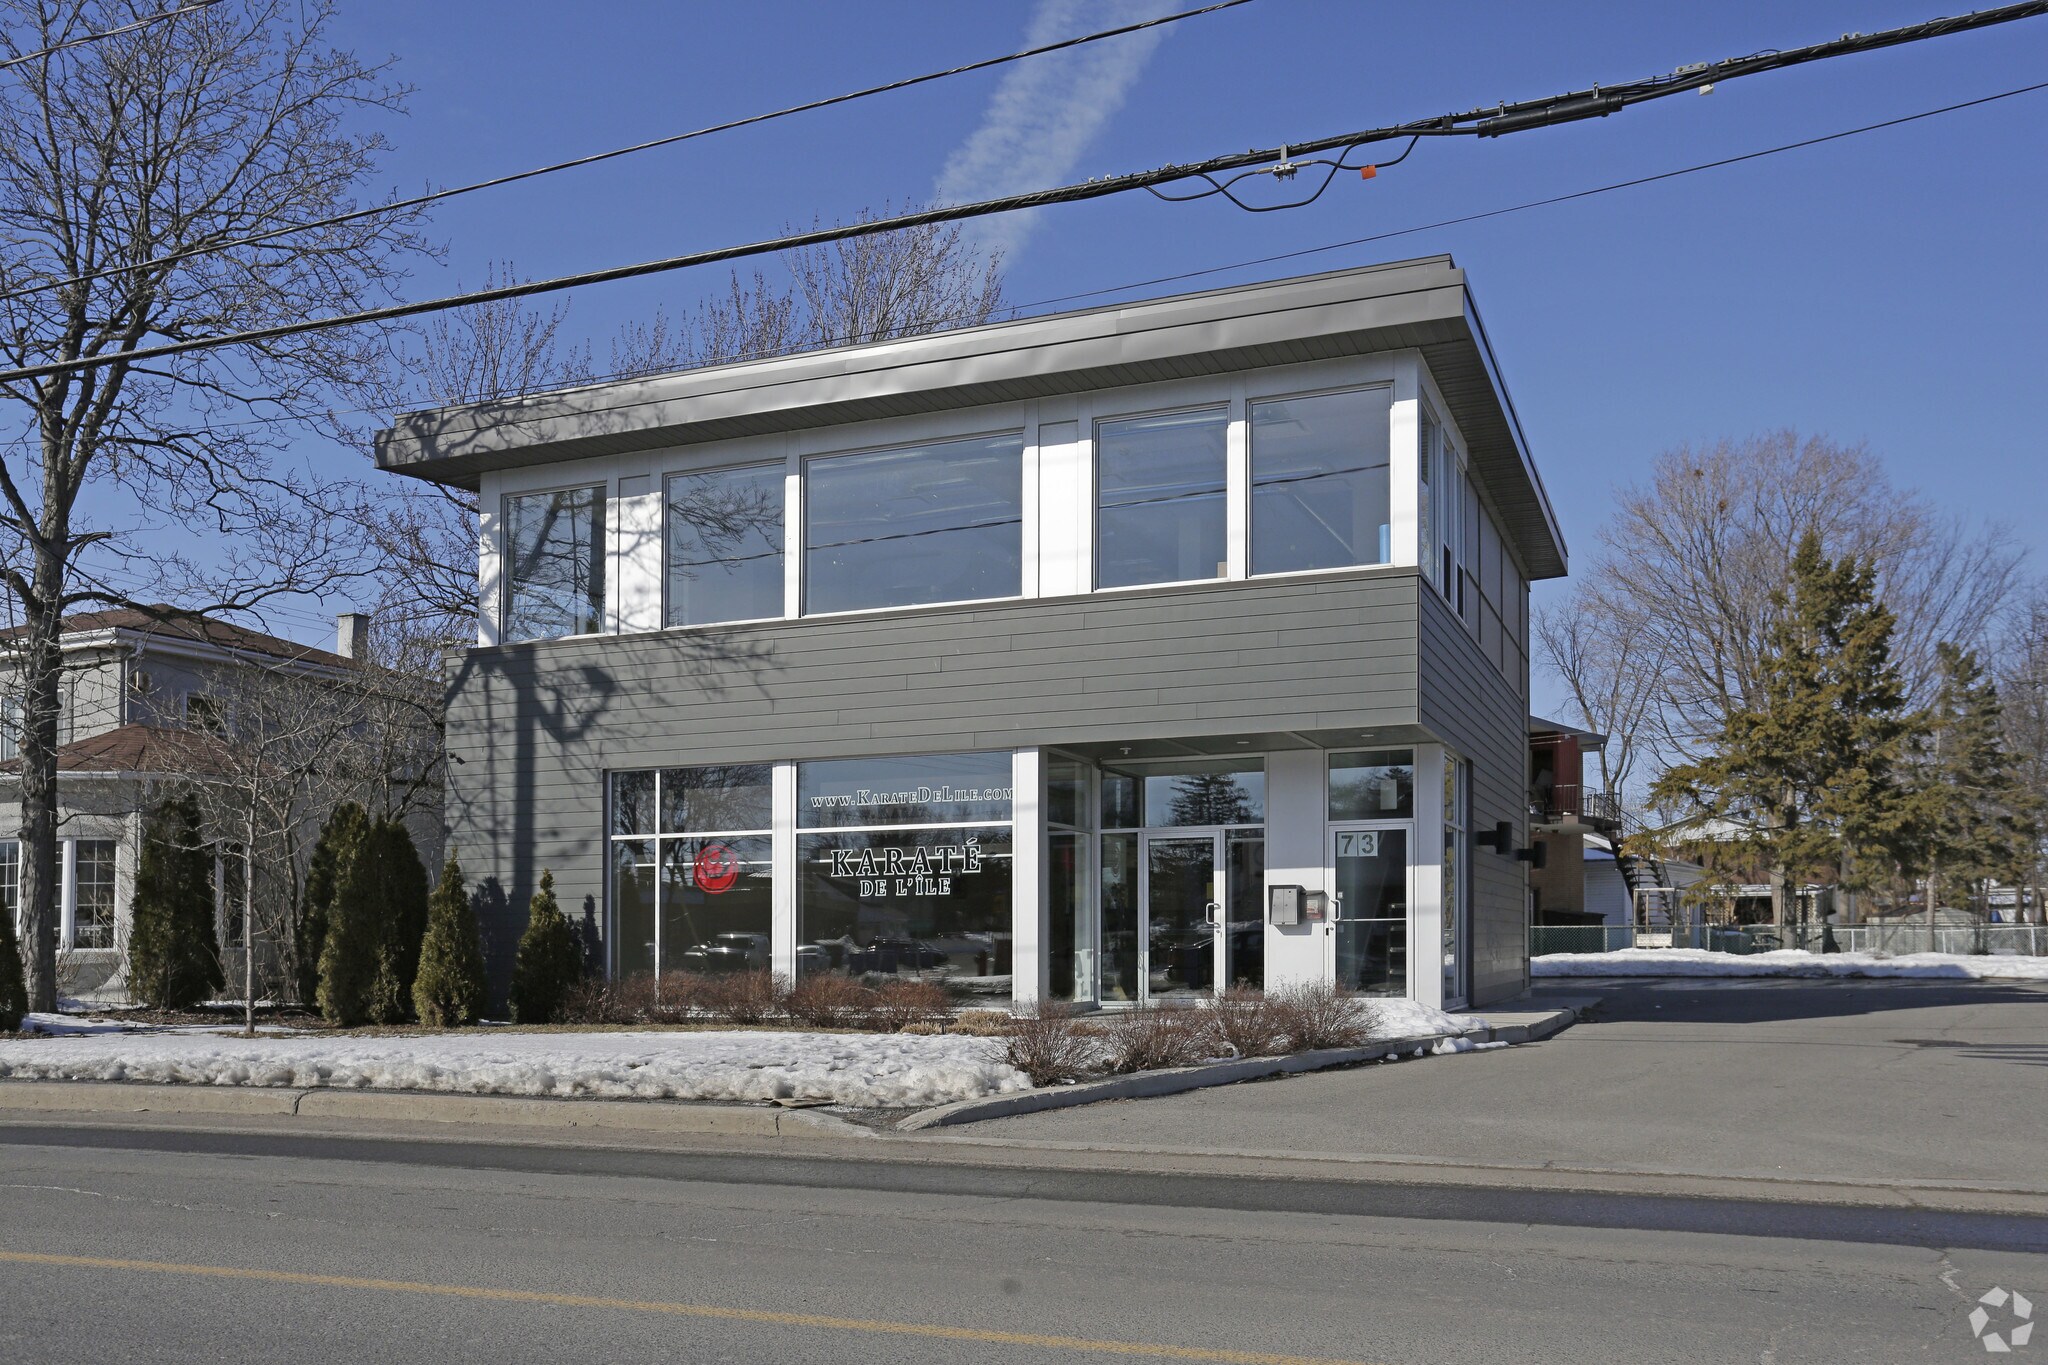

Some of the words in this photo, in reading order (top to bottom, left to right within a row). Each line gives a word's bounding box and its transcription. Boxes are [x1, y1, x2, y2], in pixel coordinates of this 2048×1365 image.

[1341, 834, 1374, 854] 73
[830, 837, 982, 877] KARATÉ
[860, 880, 887, 897] DE
[896, 874, 951, 896] L'ÎLE
